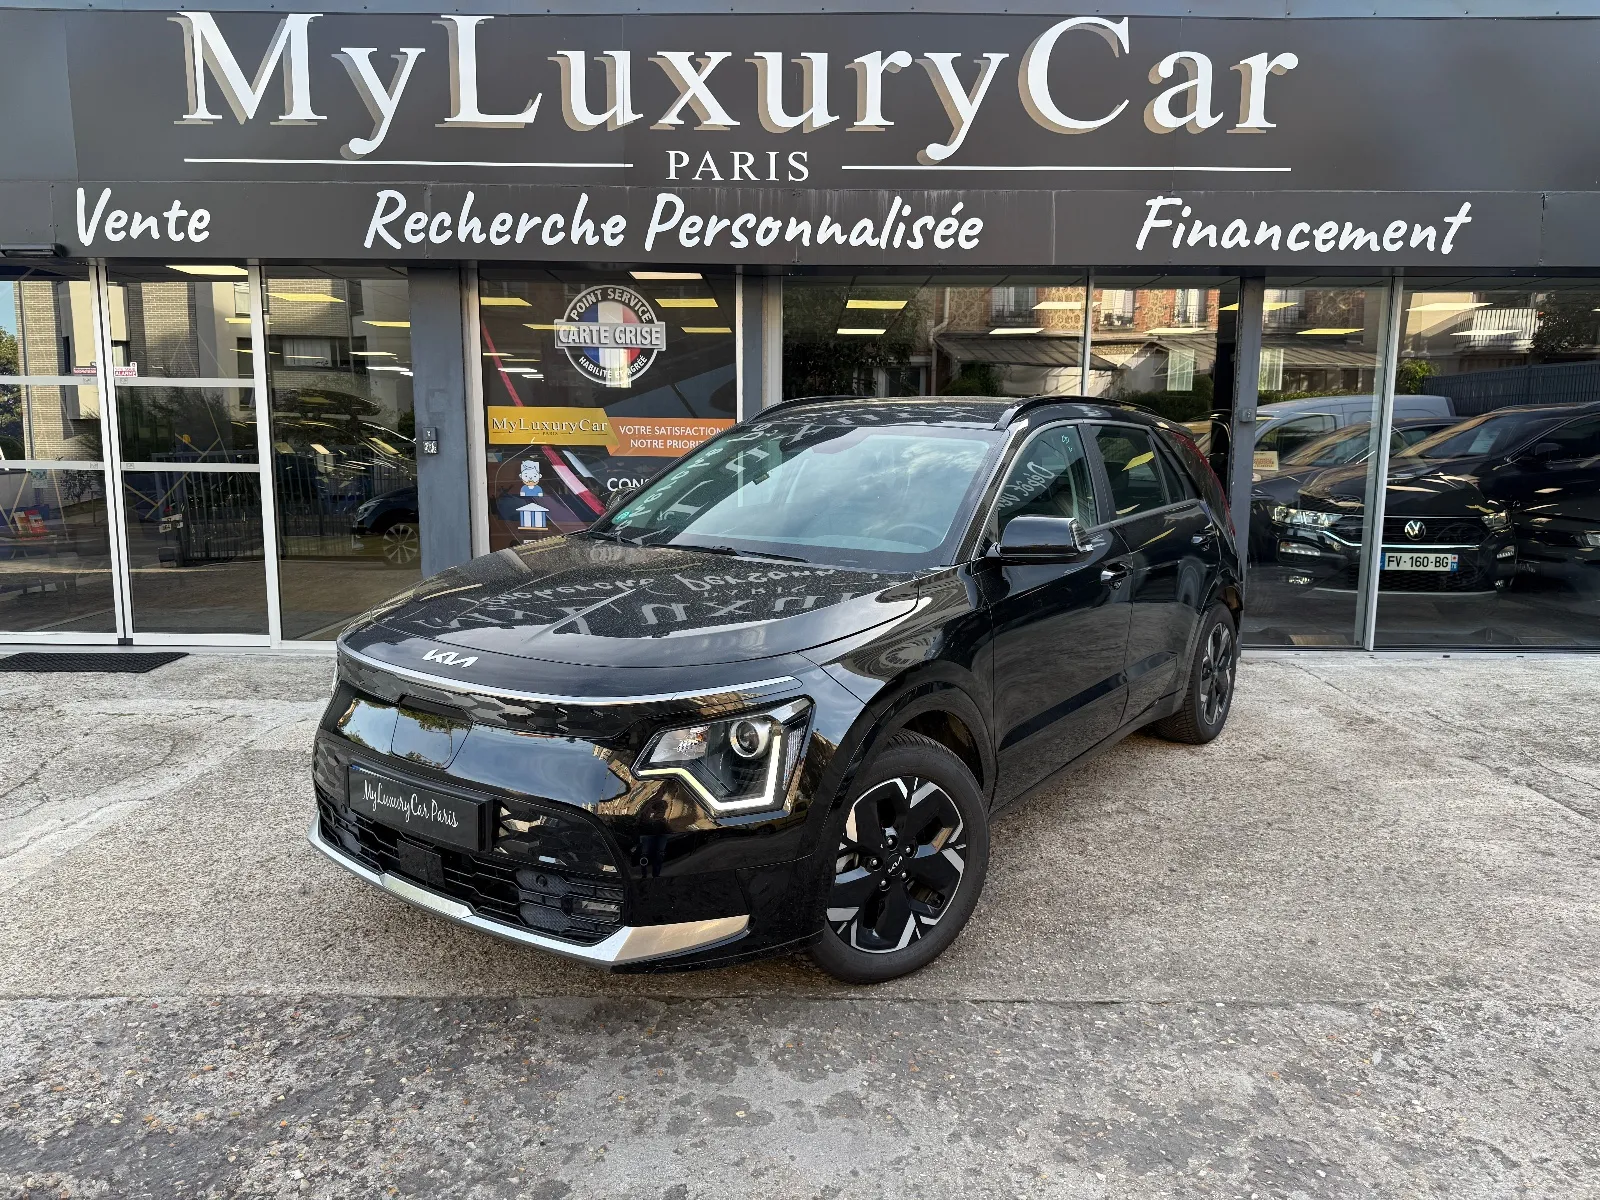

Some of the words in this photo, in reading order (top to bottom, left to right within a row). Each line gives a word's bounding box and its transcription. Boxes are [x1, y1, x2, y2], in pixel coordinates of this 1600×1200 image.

[168, 11, 1298, 164] MyLuxuryCar
[665, 150, 810, 182] PARIS
[76, 187, 211, 247] Vente
[364, 189, 626, 250] Recherche
[645, 192, 984, 252] Personnalisée
[1136, 196, 1473, 255] Financement
[570, 289, 602, 321] POINT
[607, 288, 652, 323] SERVICE
[559, 324, 610, 345] CARTE
[614, 326, 661, 345] GRISE
[492, 417, 608, 434] MyLuxuryCar
[619, 425, 652, 435] VOTRE
[630, 439, 664, 449] NOTRE
[606, 477, 651, 492] CON
[1387, 555, 1449, 568] FV-160-BG
[421, 648, 479, 669] KIA
[362, 779, 430, 823] MyLuxuryCar
[431, 798, 459, 828] Paris
